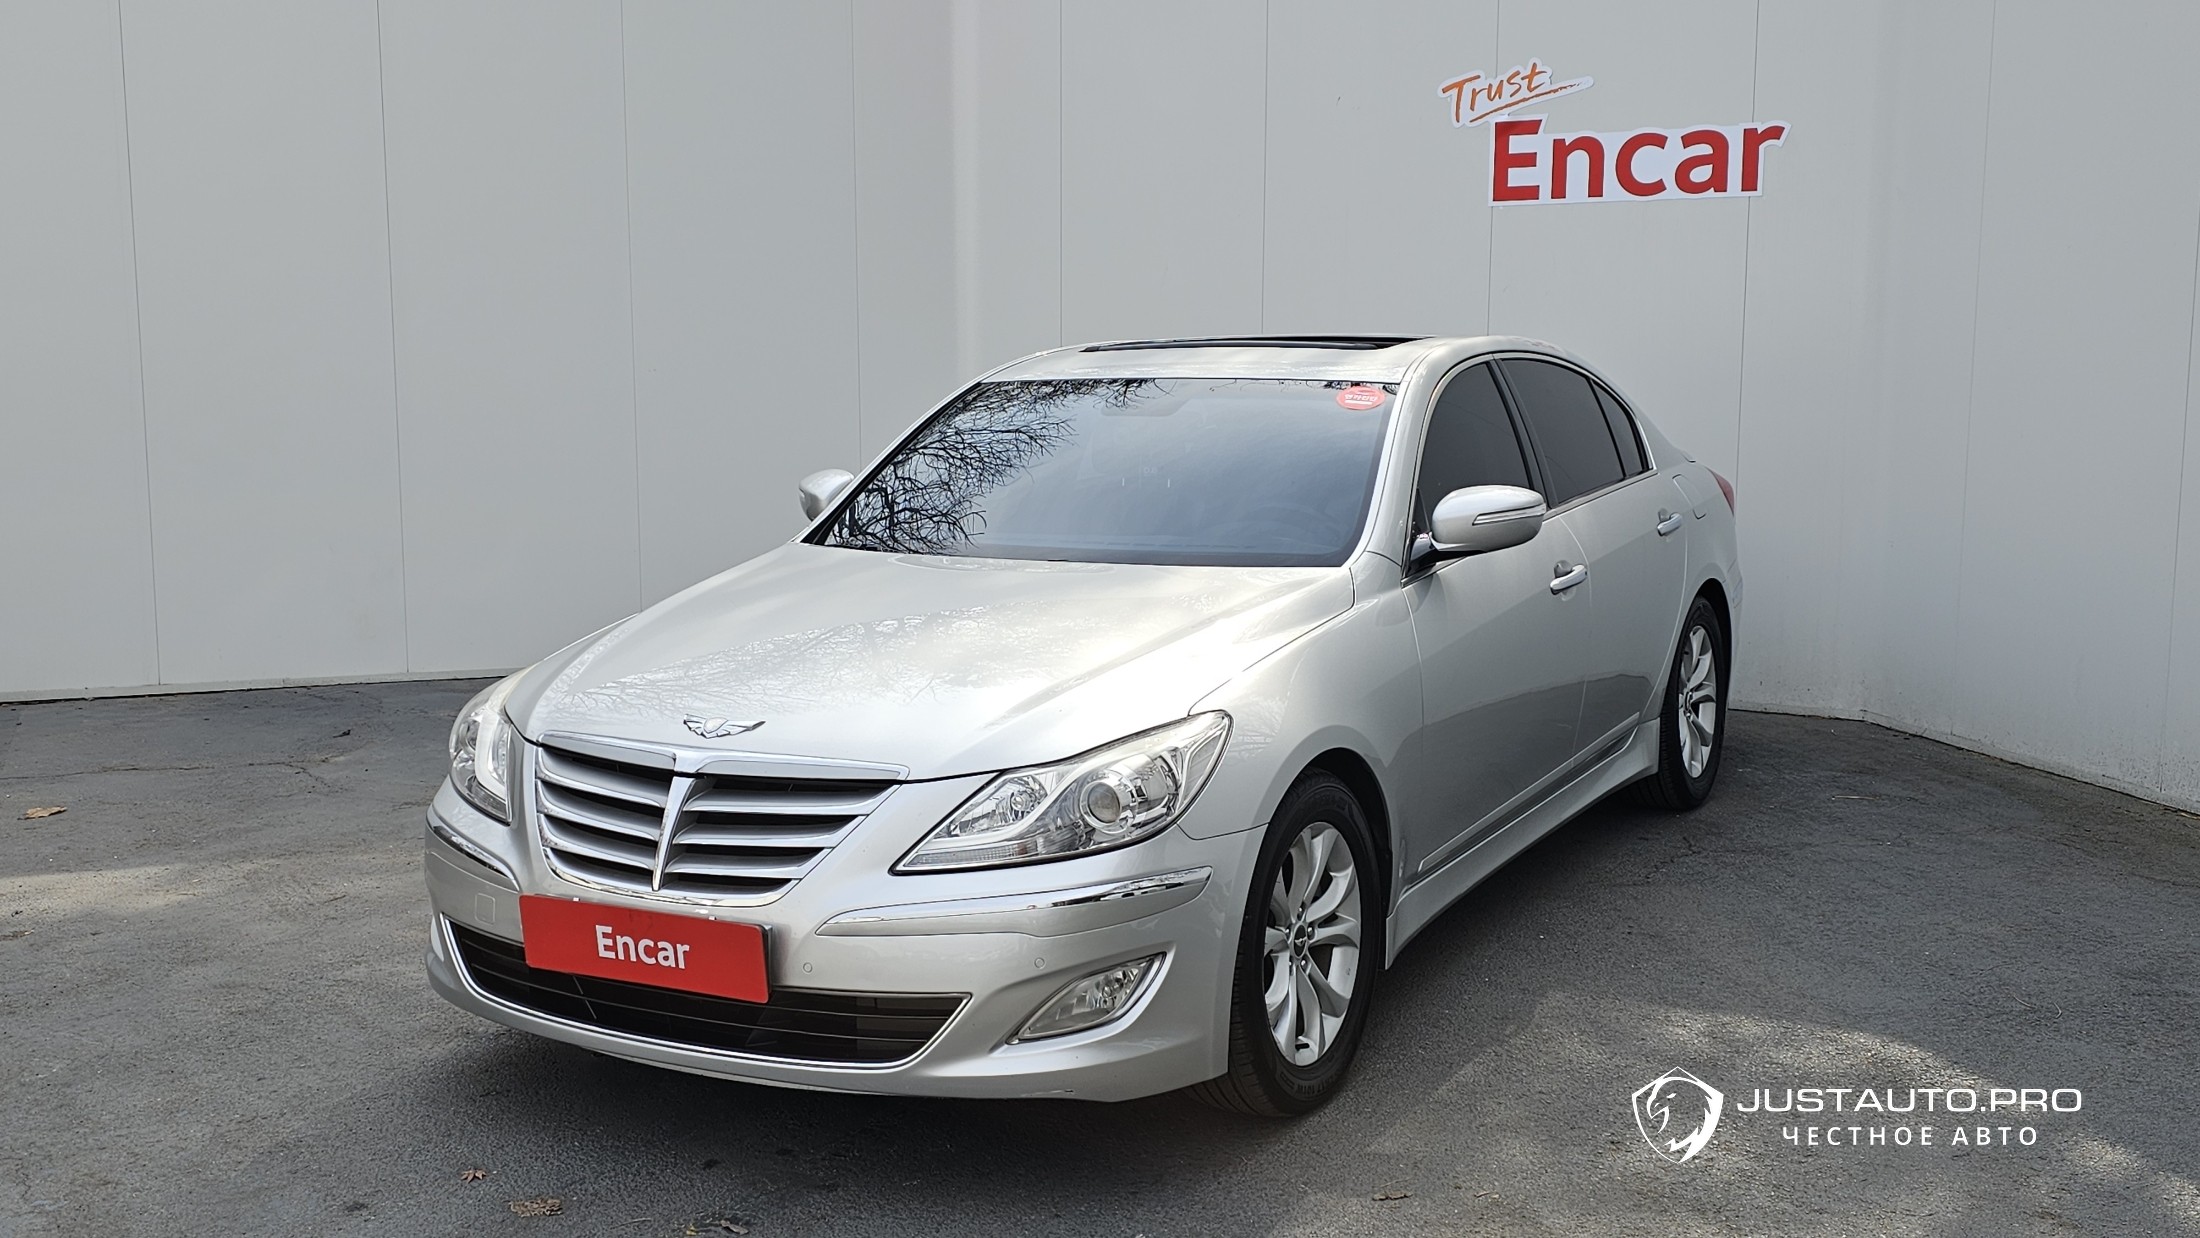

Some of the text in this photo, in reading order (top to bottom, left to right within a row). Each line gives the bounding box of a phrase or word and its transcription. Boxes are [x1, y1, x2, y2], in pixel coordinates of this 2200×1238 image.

[1442, 62, 1547, 123] Trust
[1492, 119, 1785, 202] Encar
[595, 924, 690, 969] Encar
